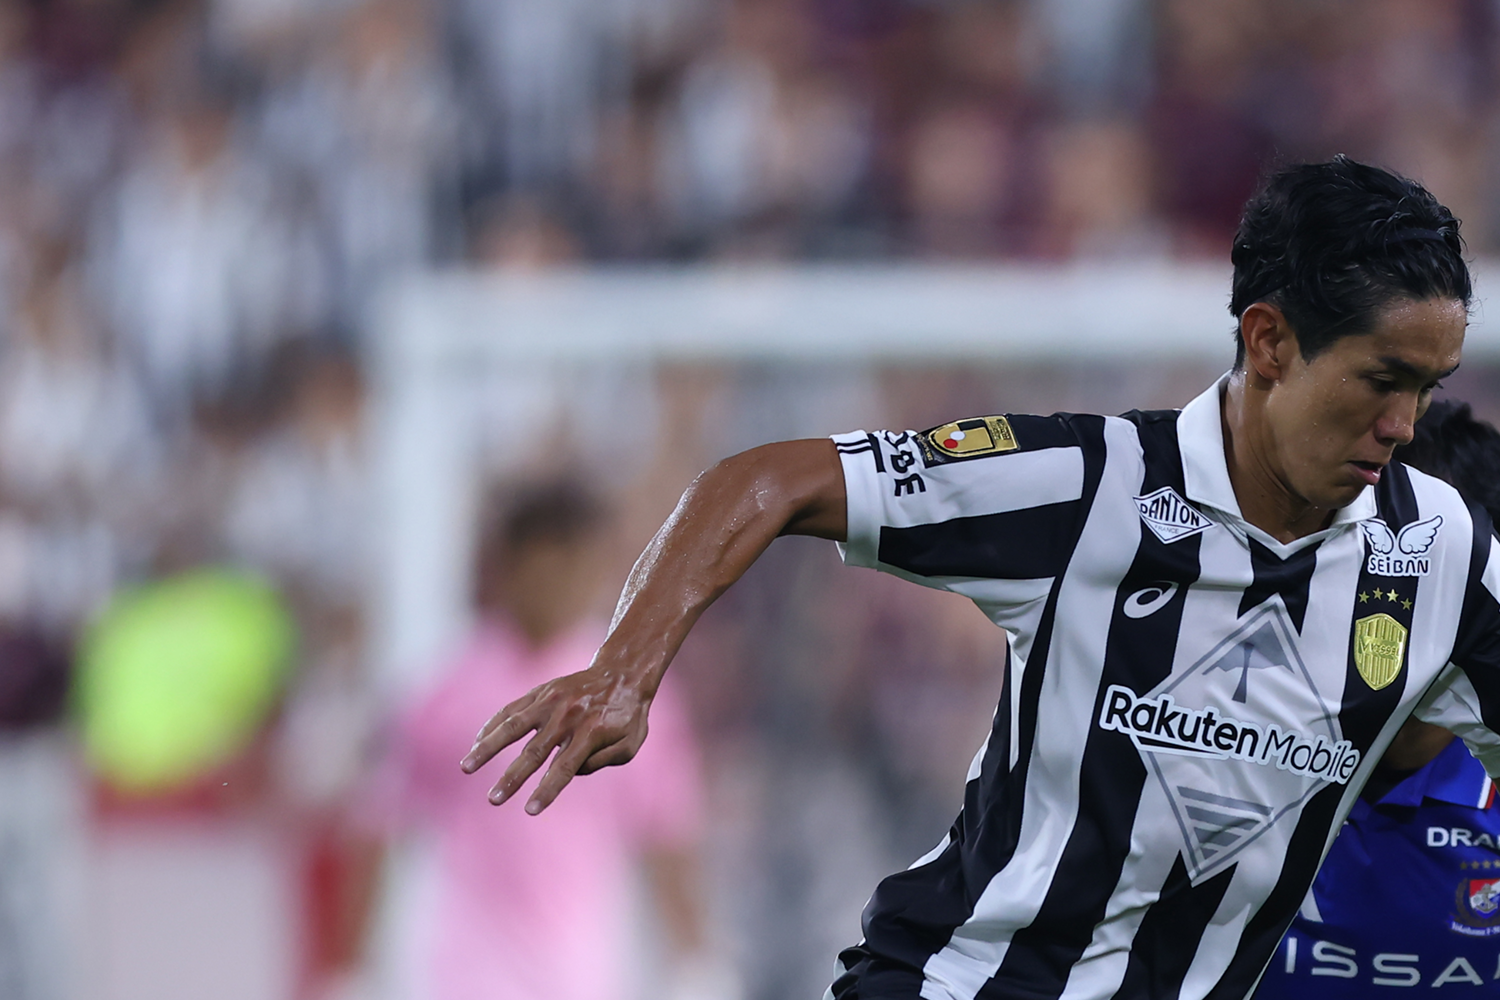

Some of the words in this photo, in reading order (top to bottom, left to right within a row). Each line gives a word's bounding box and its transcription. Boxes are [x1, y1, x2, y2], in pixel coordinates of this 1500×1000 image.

[1140, 493, 1200, 527] DANTON
[1154, 524, 1179, 535] FRANCE
[1105, 696, 1259, 758] Rakuten
[1261, 729, 1359, 781] Mobile
